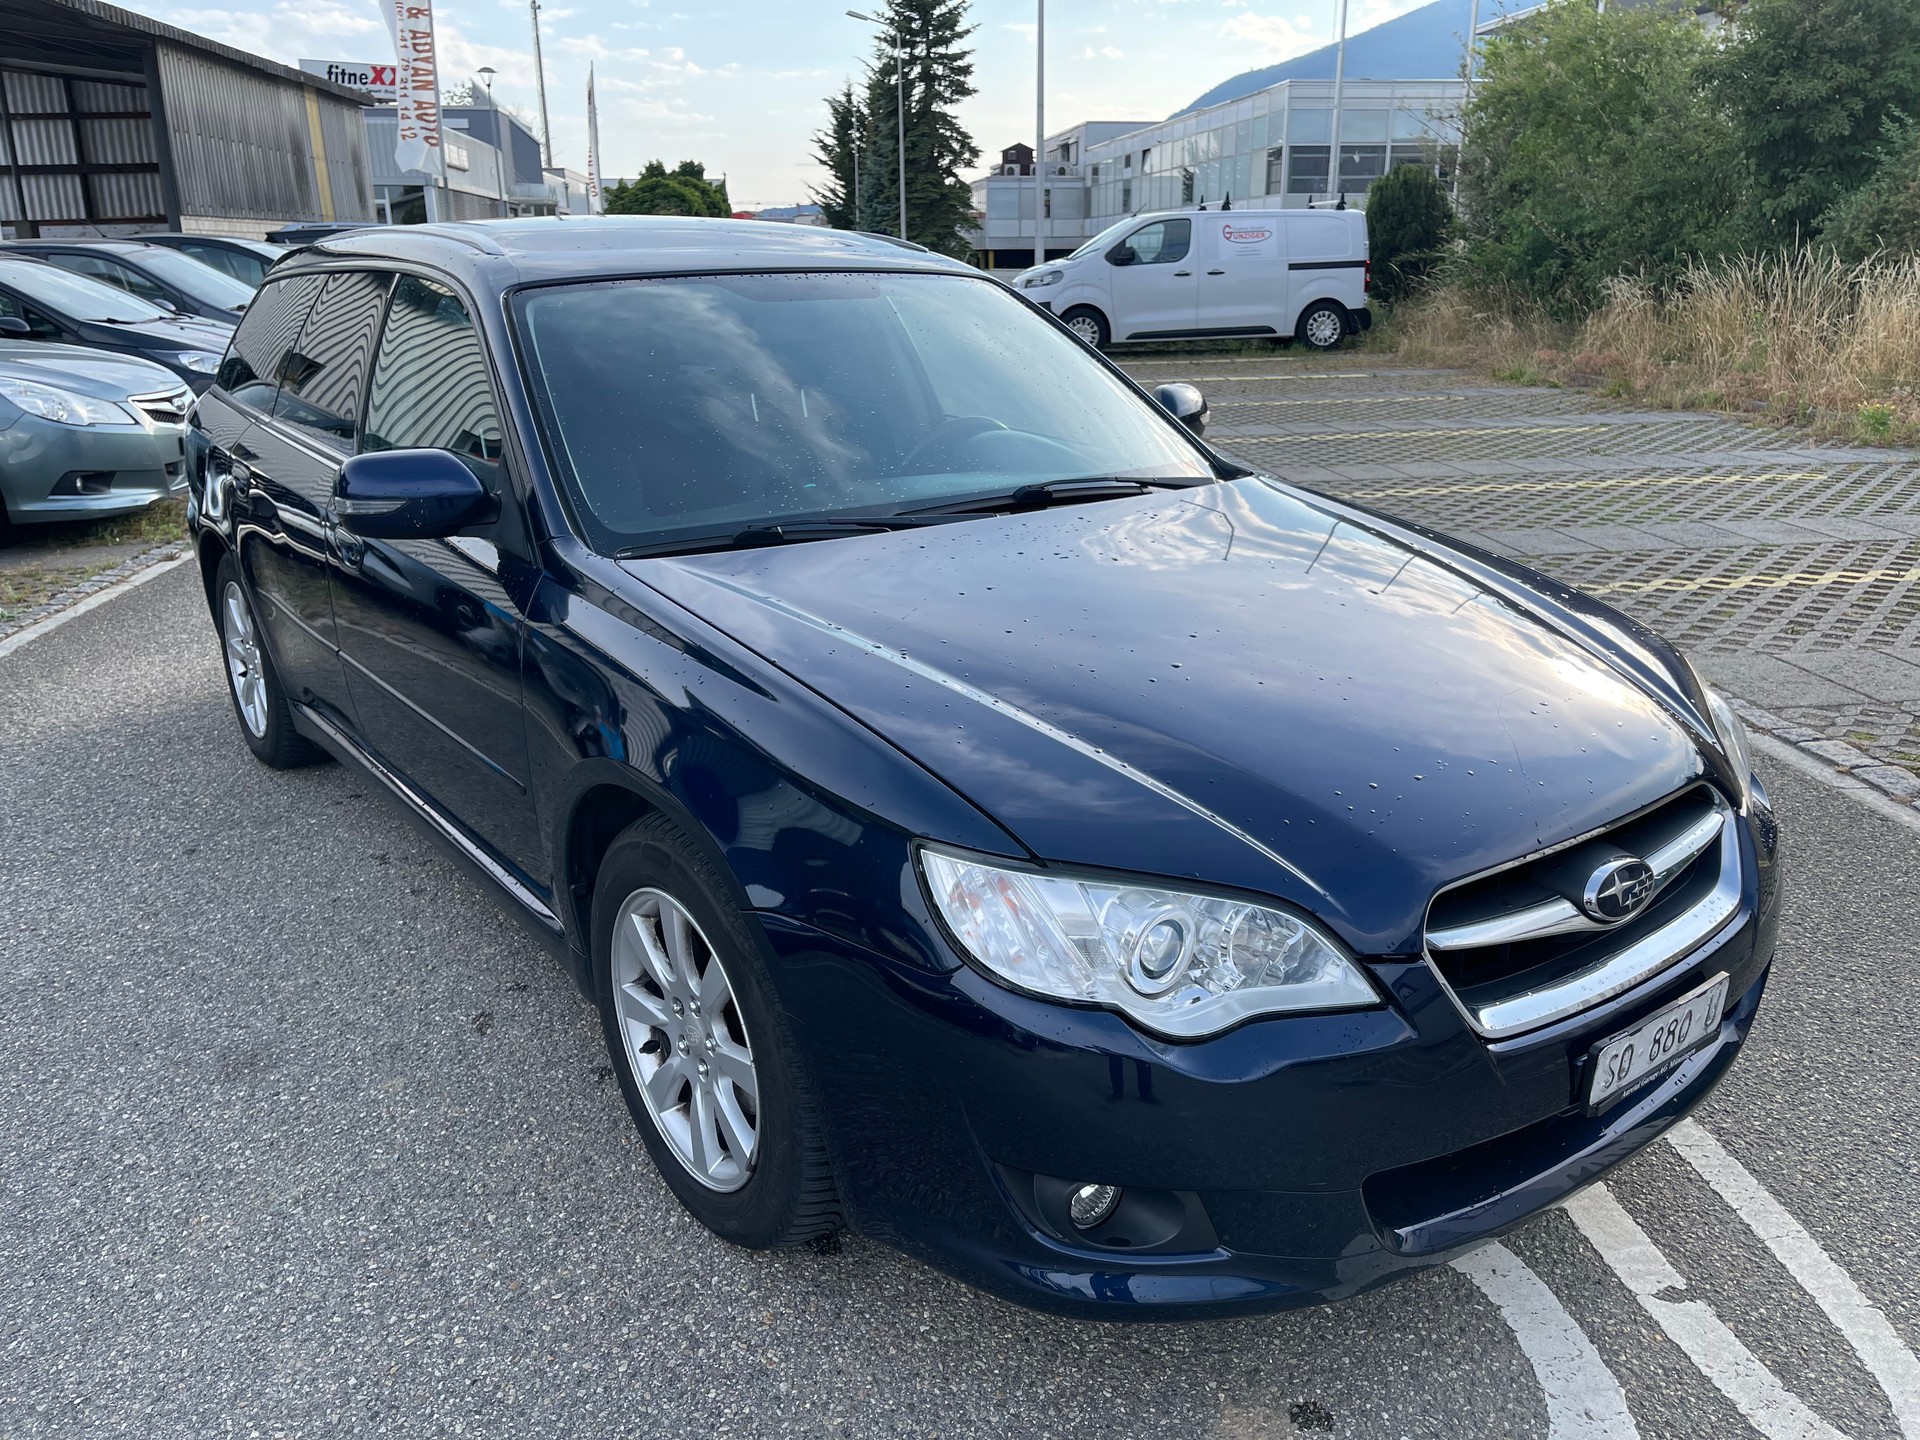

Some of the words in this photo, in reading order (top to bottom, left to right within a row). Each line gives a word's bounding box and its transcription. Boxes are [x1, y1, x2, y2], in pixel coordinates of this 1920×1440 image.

[406, 7, 430, 19] &
[400, 77, 410, 97] 211
[400, 106, 412, 120] 14
[413, 100, 440, 147] AUTO
[401, 126, 418, 141] 12
[1601, 1043, 1634, 1092] SO
[1649, 1008, 1692, 1063] 880
[1704, 987, 1722, 1029] U
